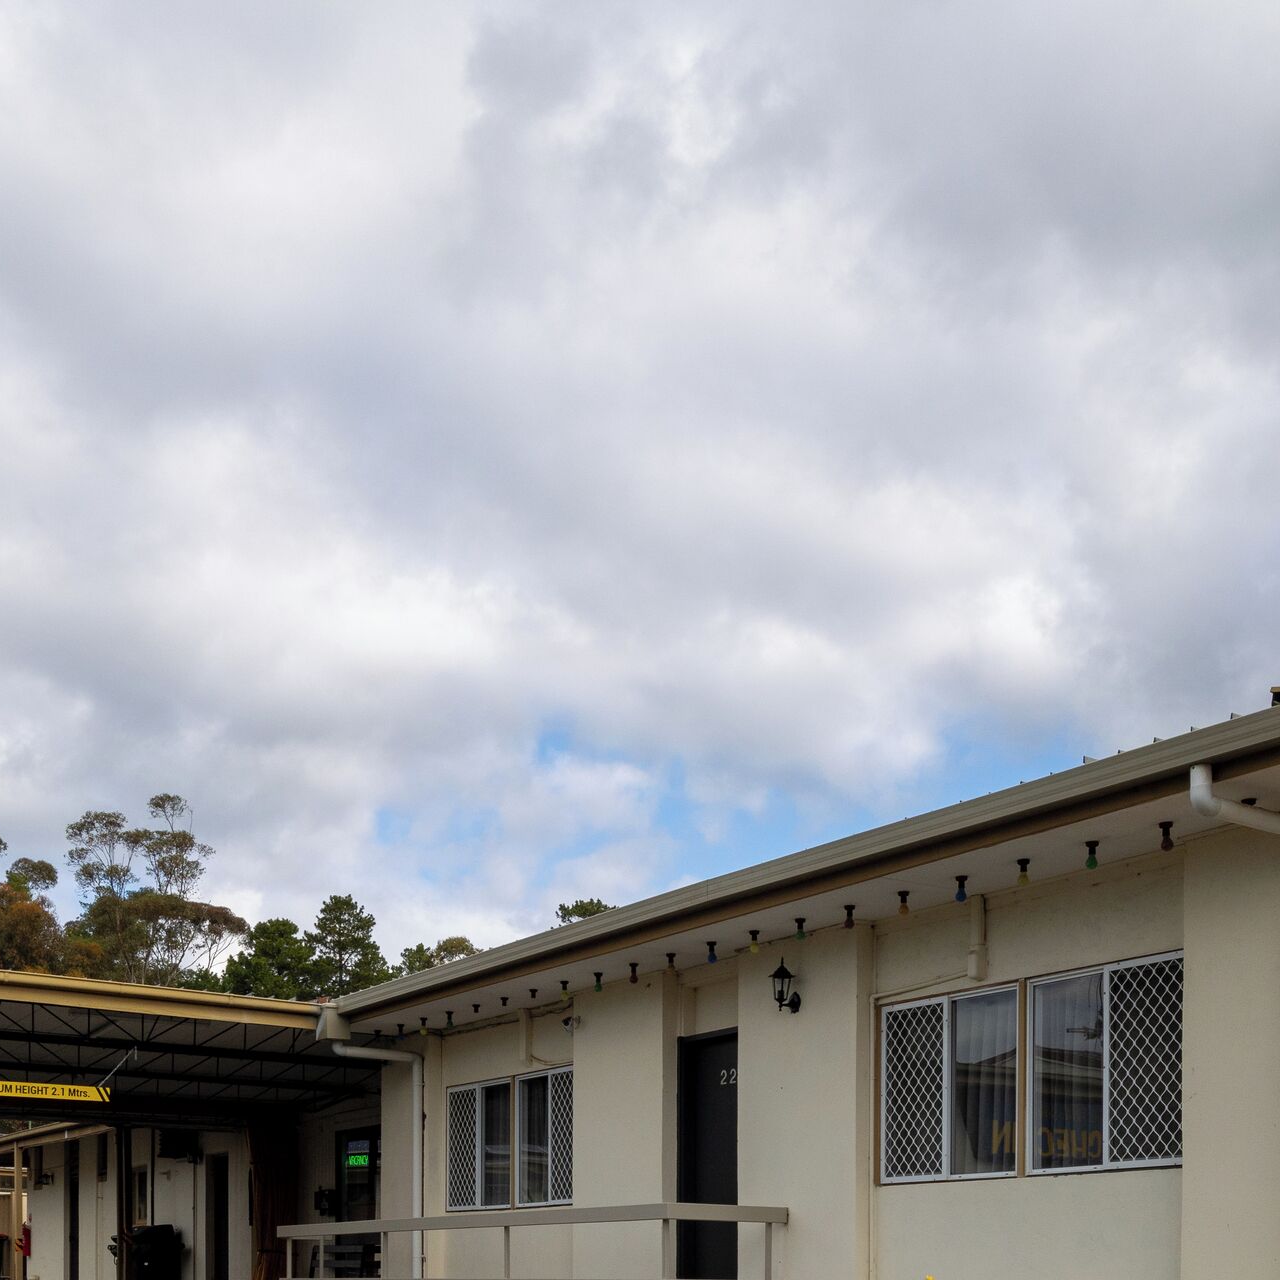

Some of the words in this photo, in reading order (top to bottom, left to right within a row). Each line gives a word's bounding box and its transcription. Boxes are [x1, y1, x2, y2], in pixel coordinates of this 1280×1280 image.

[720, 1068, 737, 1085] 22
[15, 1084, 48, 1096] HEIGHT
[51, 1087, 65, 1096] 2.1
[68, 1088, 91, 1098] Mtrs.
